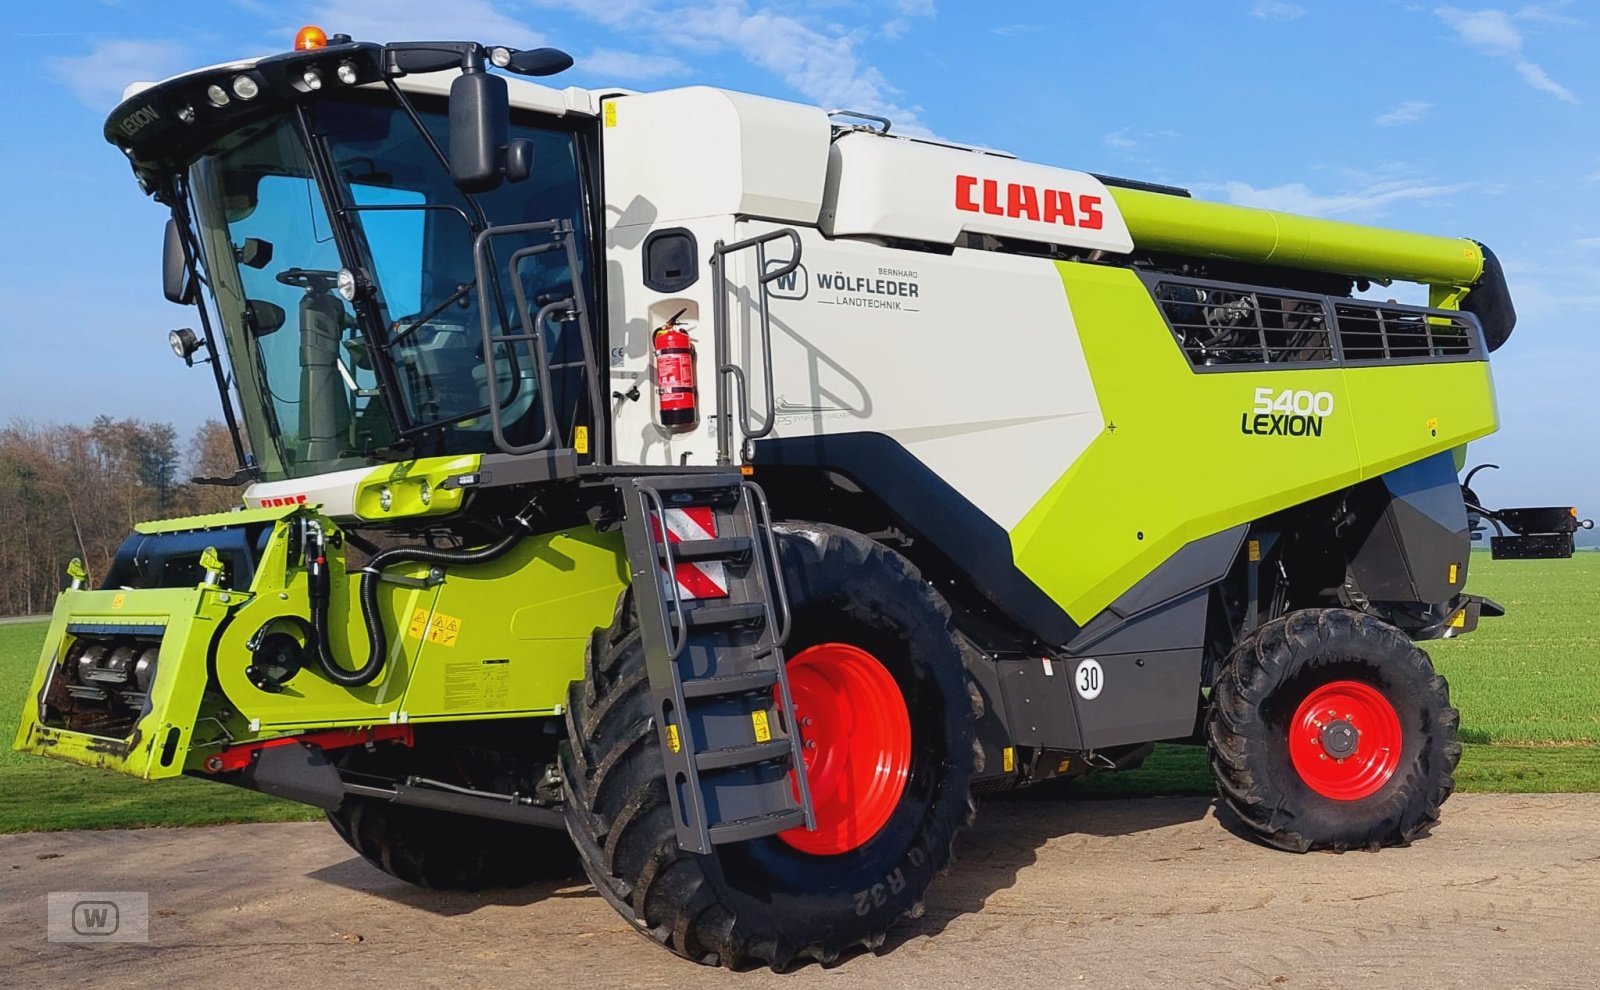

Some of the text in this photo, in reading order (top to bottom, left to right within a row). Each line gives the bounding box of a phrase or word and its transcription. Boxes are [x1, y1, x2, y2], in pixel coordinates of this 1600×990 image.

[119, 104, 160, 136] LEXION
[955, 174, 1103, 230] CLAAS
[816, 270, 919, 298] WÖLFLEDER
[877, 267, 918, 279] BERNHARD
[836, 296, 902, 311] LANDTECHNIK
[1253, 387, 1335, 417] 5400
[1241, 413, 1323, 437] LEXION
[1080, 666, 1099, 691] 30
